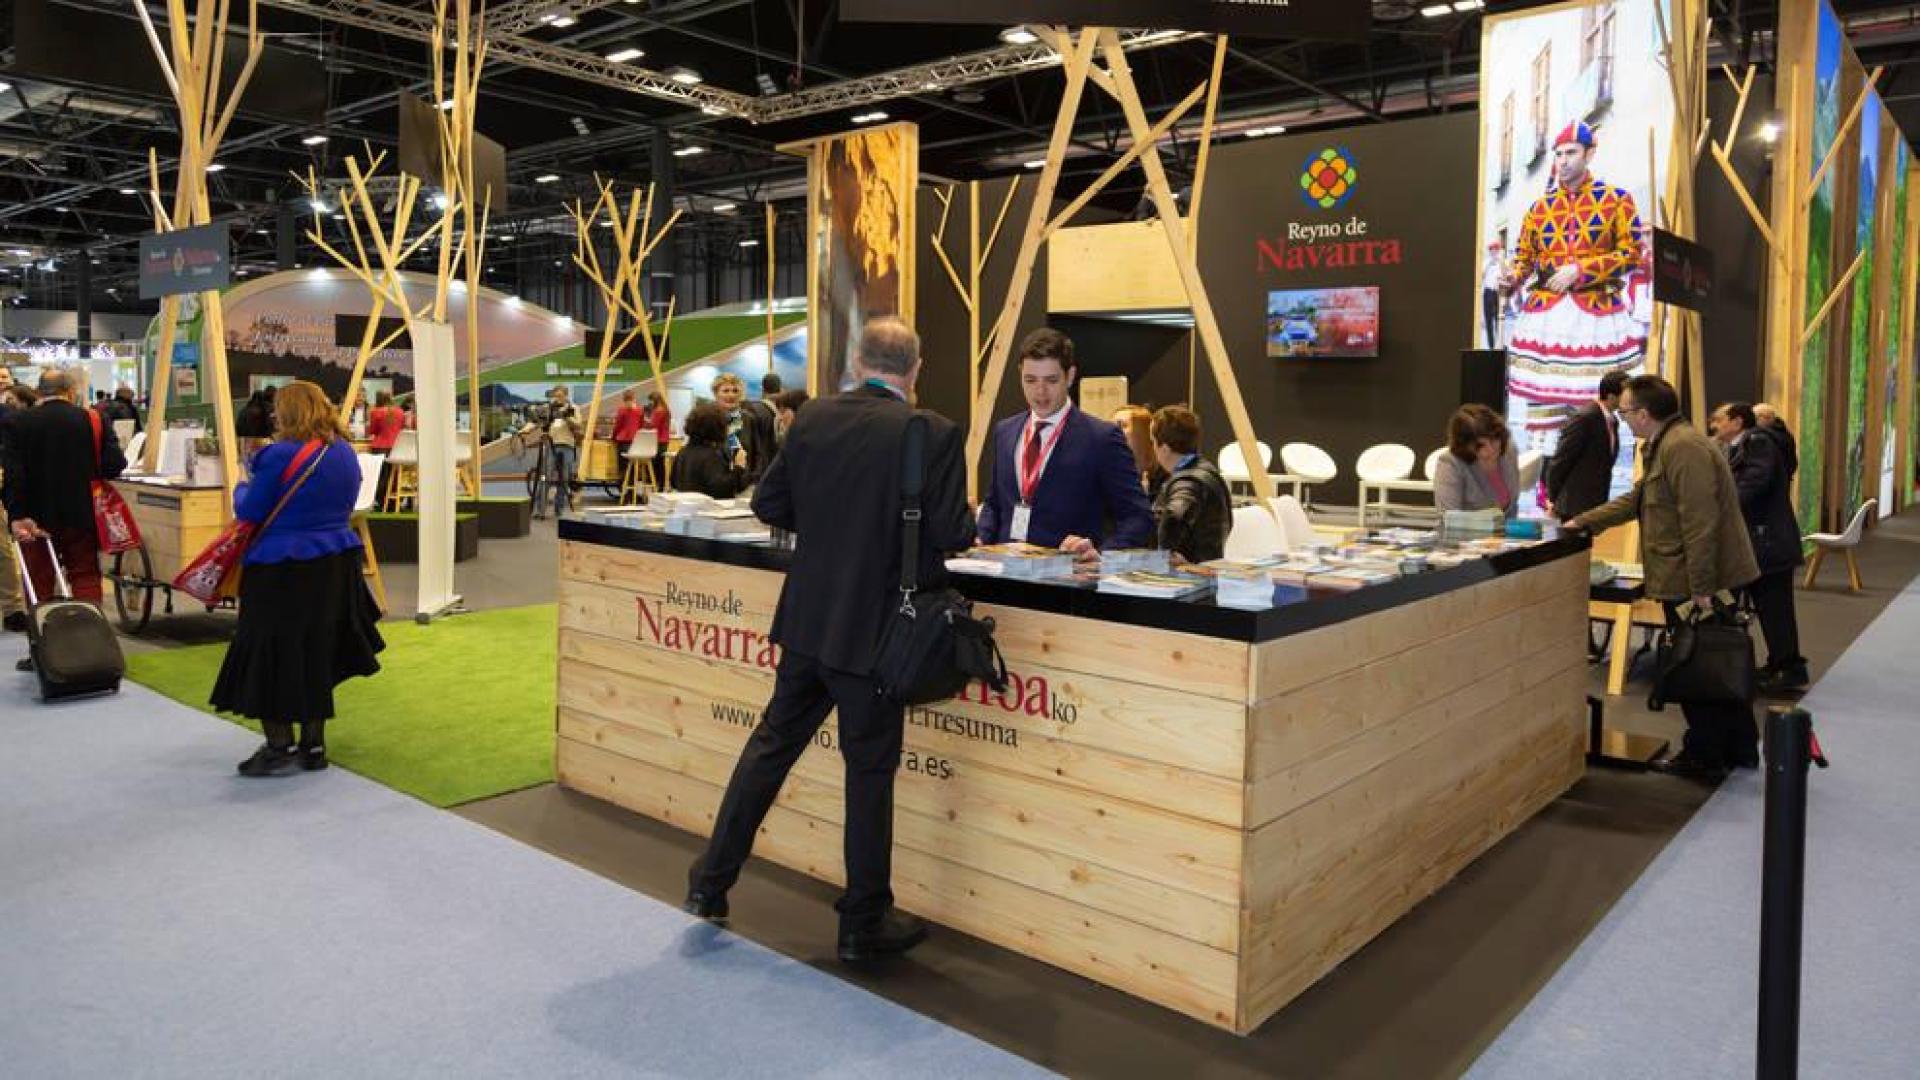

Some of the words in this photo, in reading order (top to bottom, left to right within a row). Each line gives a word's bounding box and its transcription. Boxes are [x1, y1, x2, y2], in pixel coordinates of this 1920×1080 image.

[1287, 222, 1341, 244] Reyno
[1345, 217, 1367, 236] de
[1255, 237, 1402, 273] Navarra
[666, 581, 718, 614] Reyno
[720, 589, 743, 617] de
[635, 596, 778, 670] Navarra
